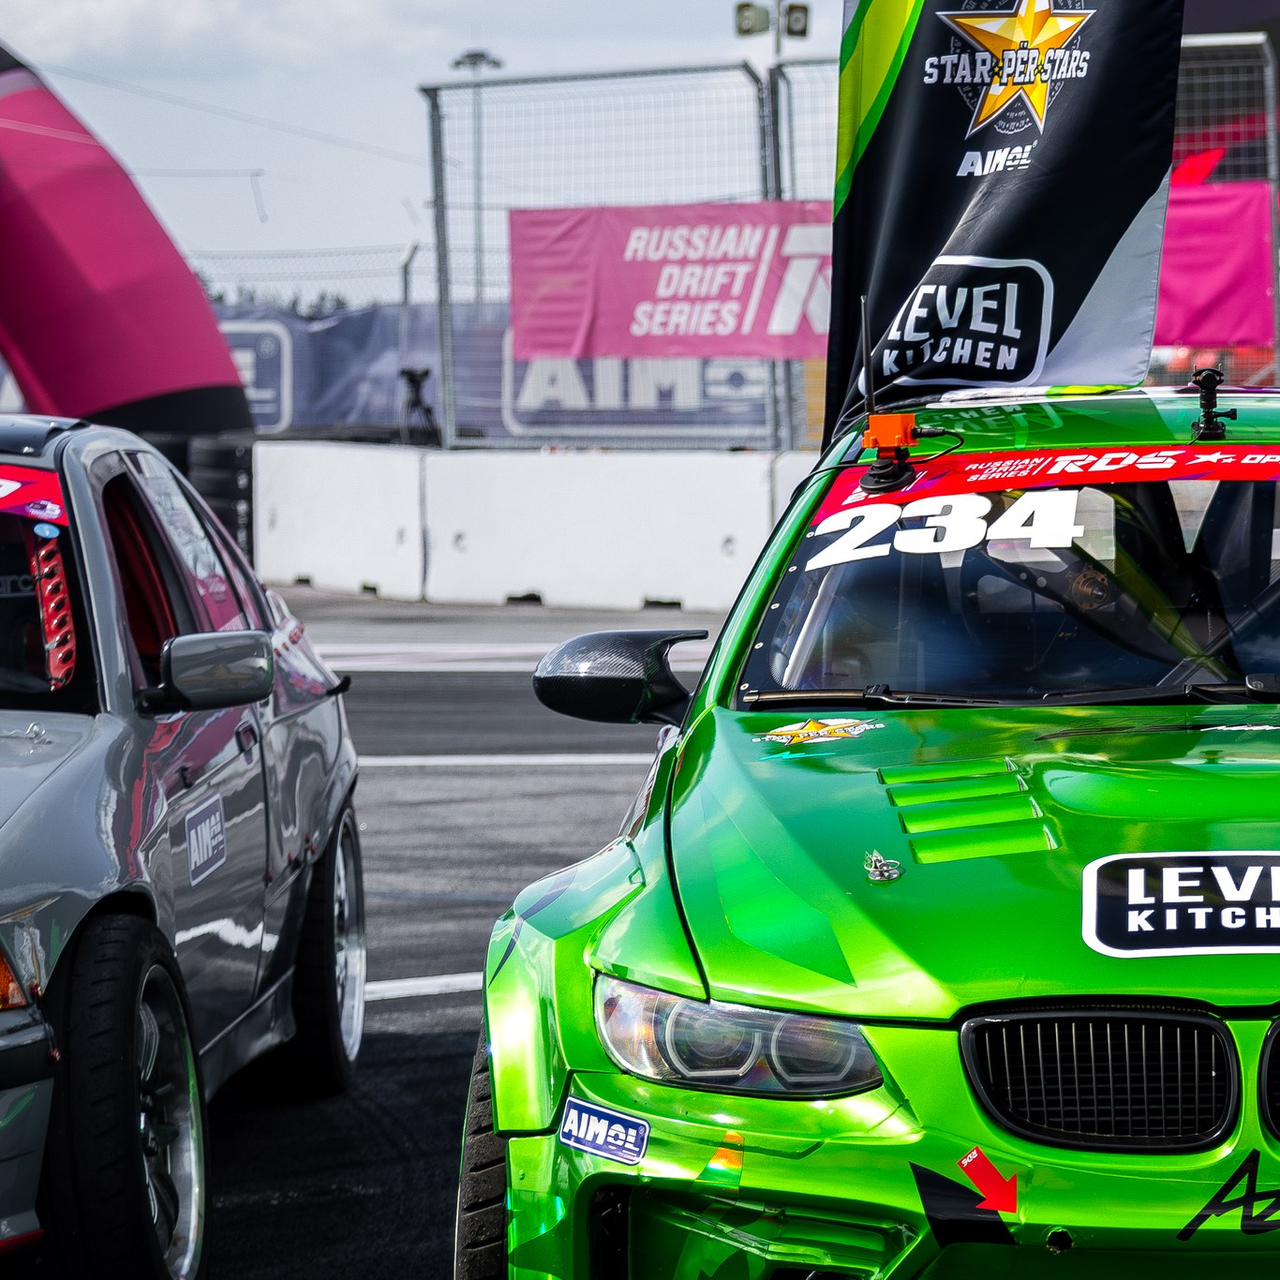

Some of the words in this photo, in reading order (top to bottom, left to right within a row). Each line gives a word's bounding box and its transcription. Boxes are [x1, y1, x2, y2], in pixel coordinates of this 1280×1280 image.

[923, 51, 993, 85] STAR
[1041, 49, 1091, 83] STARS
[956, 144, 1033, 177] AIMOL
[624, 224, 766, 262] RUSSIAN
[655, 263, 751, 299] DRIFT
[630, 300, 741, 337] SERIES
[516, 357, 768, 413] AIMO
[965, 457, 1044, 471] RUSSIAN
[967, 469, 1031, 482] SERIES
[984, 463, 1038, 474] DRIFT
[1046, 450, 1187, 476] RDS
[805, 489, 1085, 571] 234
[562, 1108, 640, 1157] AIMOL
